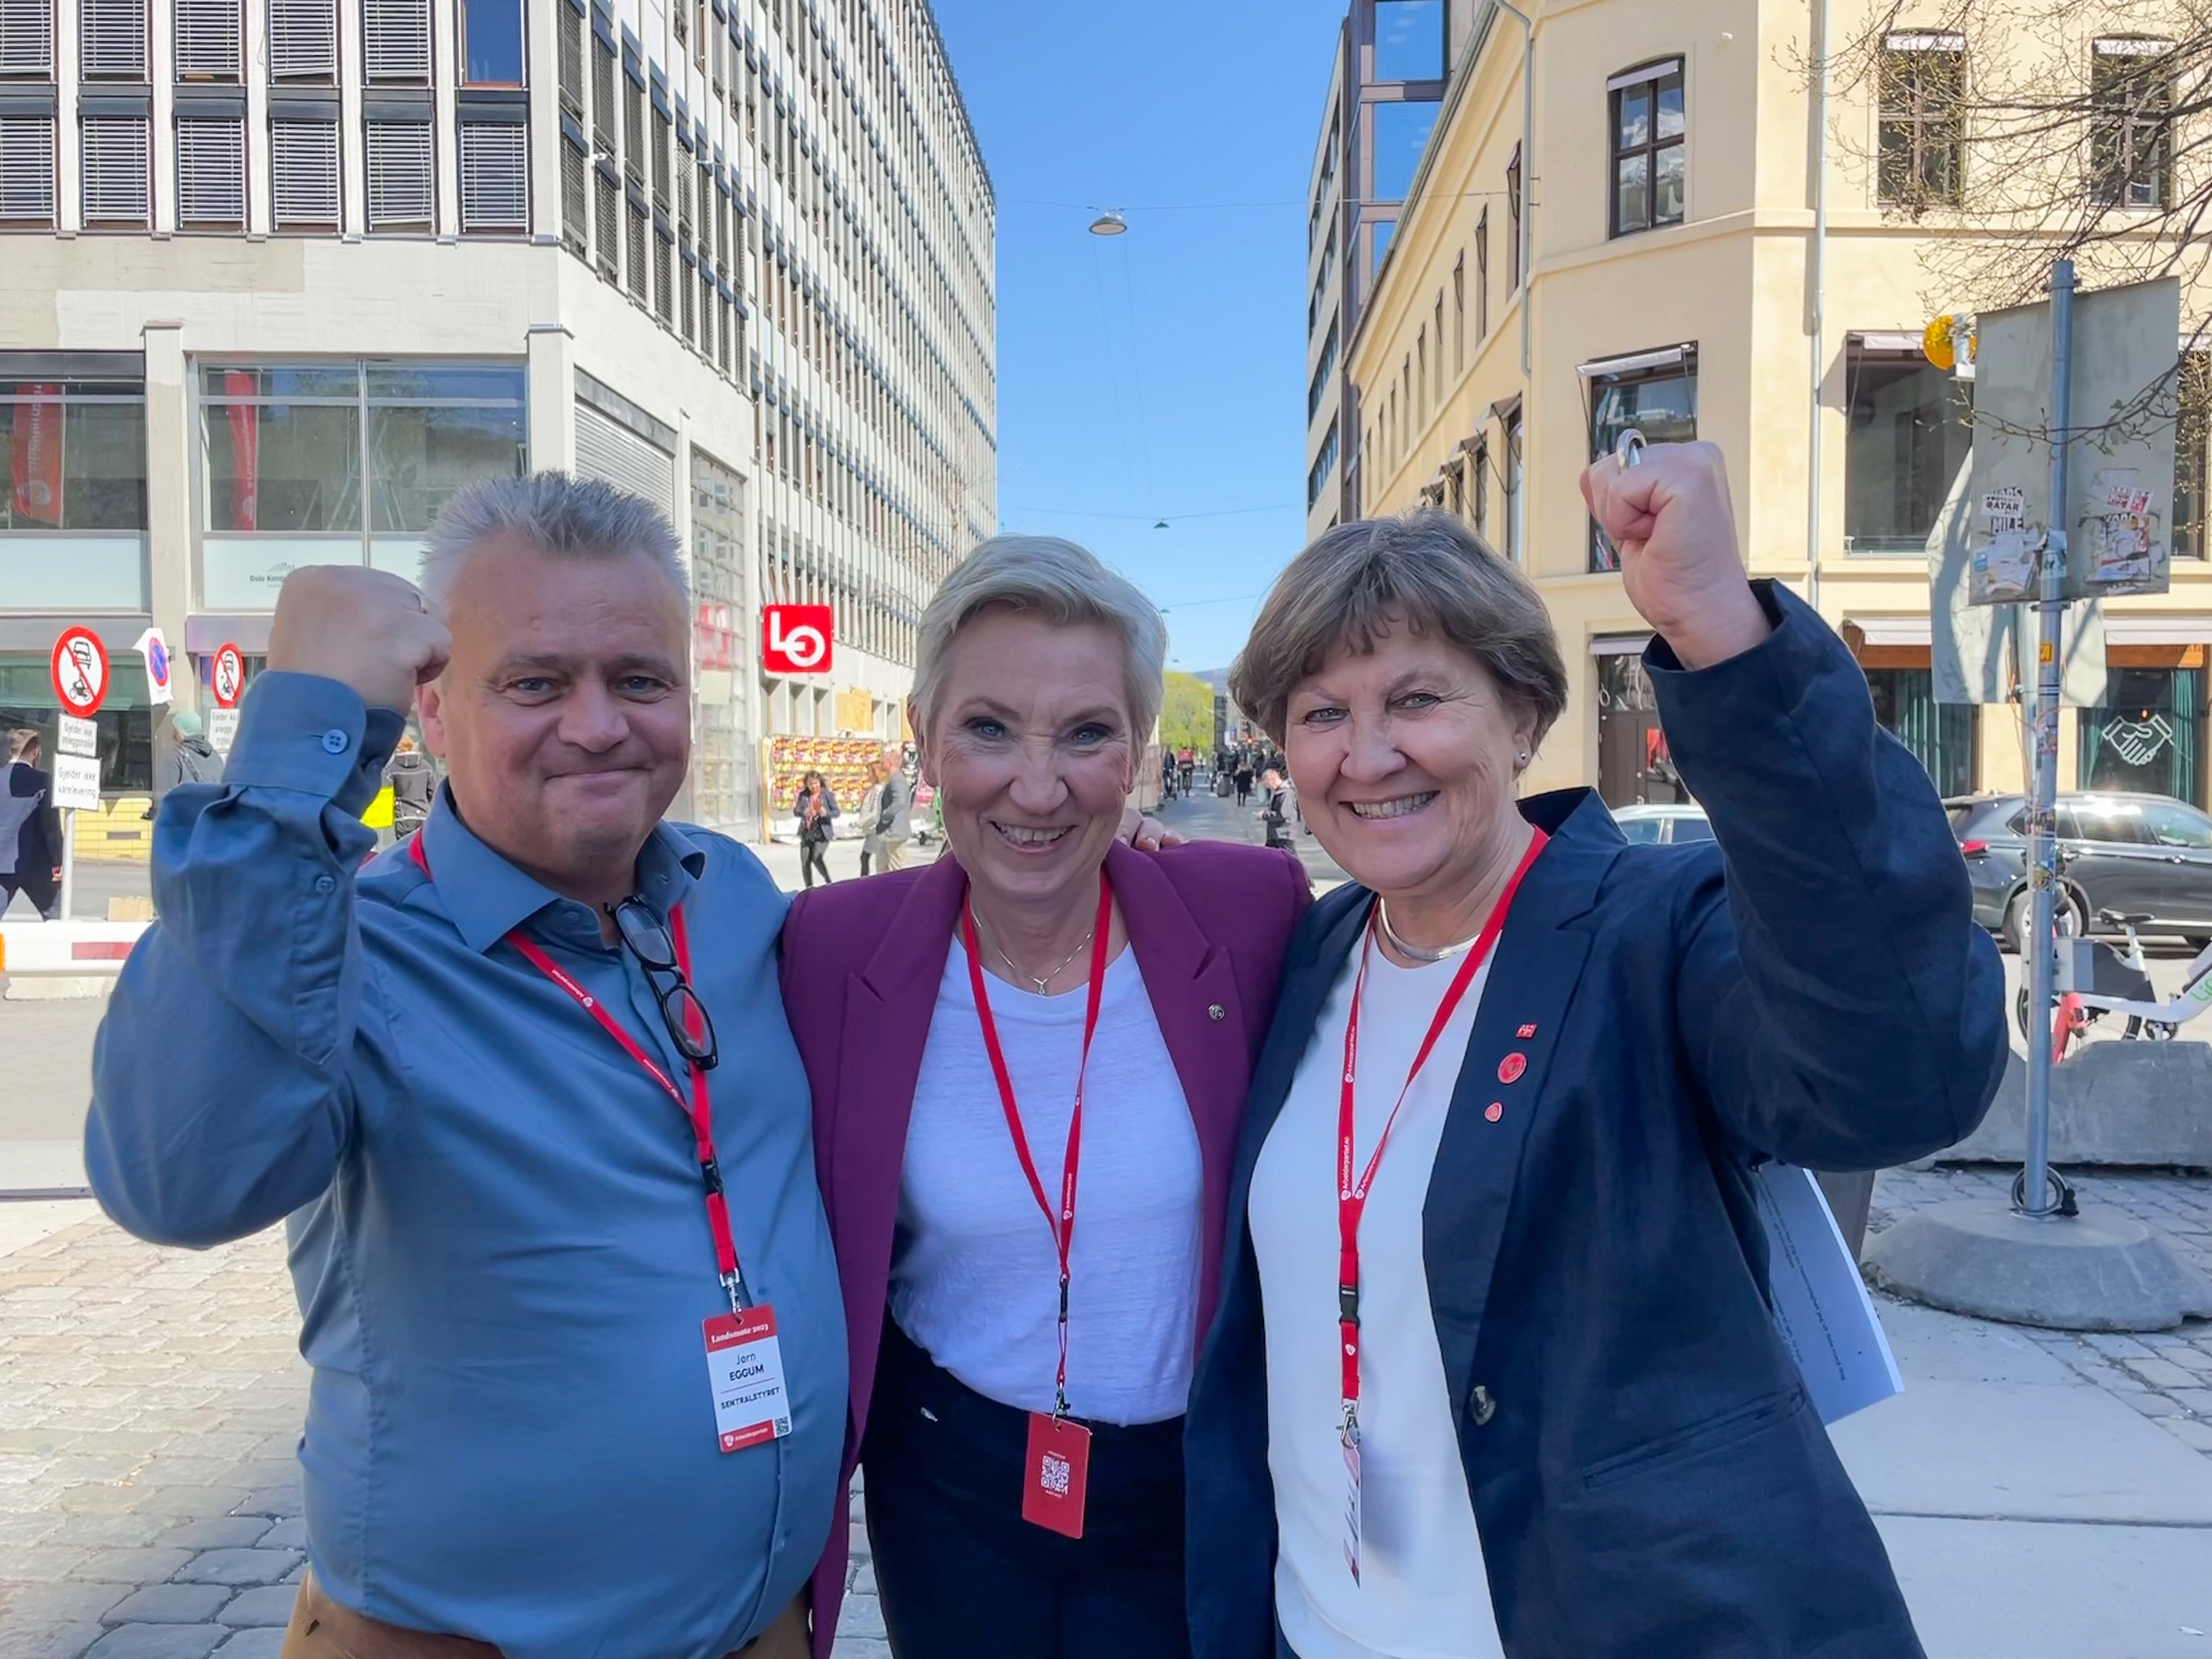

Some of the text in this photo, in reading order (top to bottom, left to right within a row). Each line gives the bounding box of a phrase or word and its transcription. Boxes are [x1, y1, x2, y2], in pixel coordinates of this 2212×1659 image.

[1986, 501, 2019, 512] QATAR
[771, 611, 825, 667] LO
[58, 767, 96, 781] Gjelder ikke
[729, 1364, 764, 1381] EGGUM
[721, 1387, 780, 1410] SENTRALSTYRET
